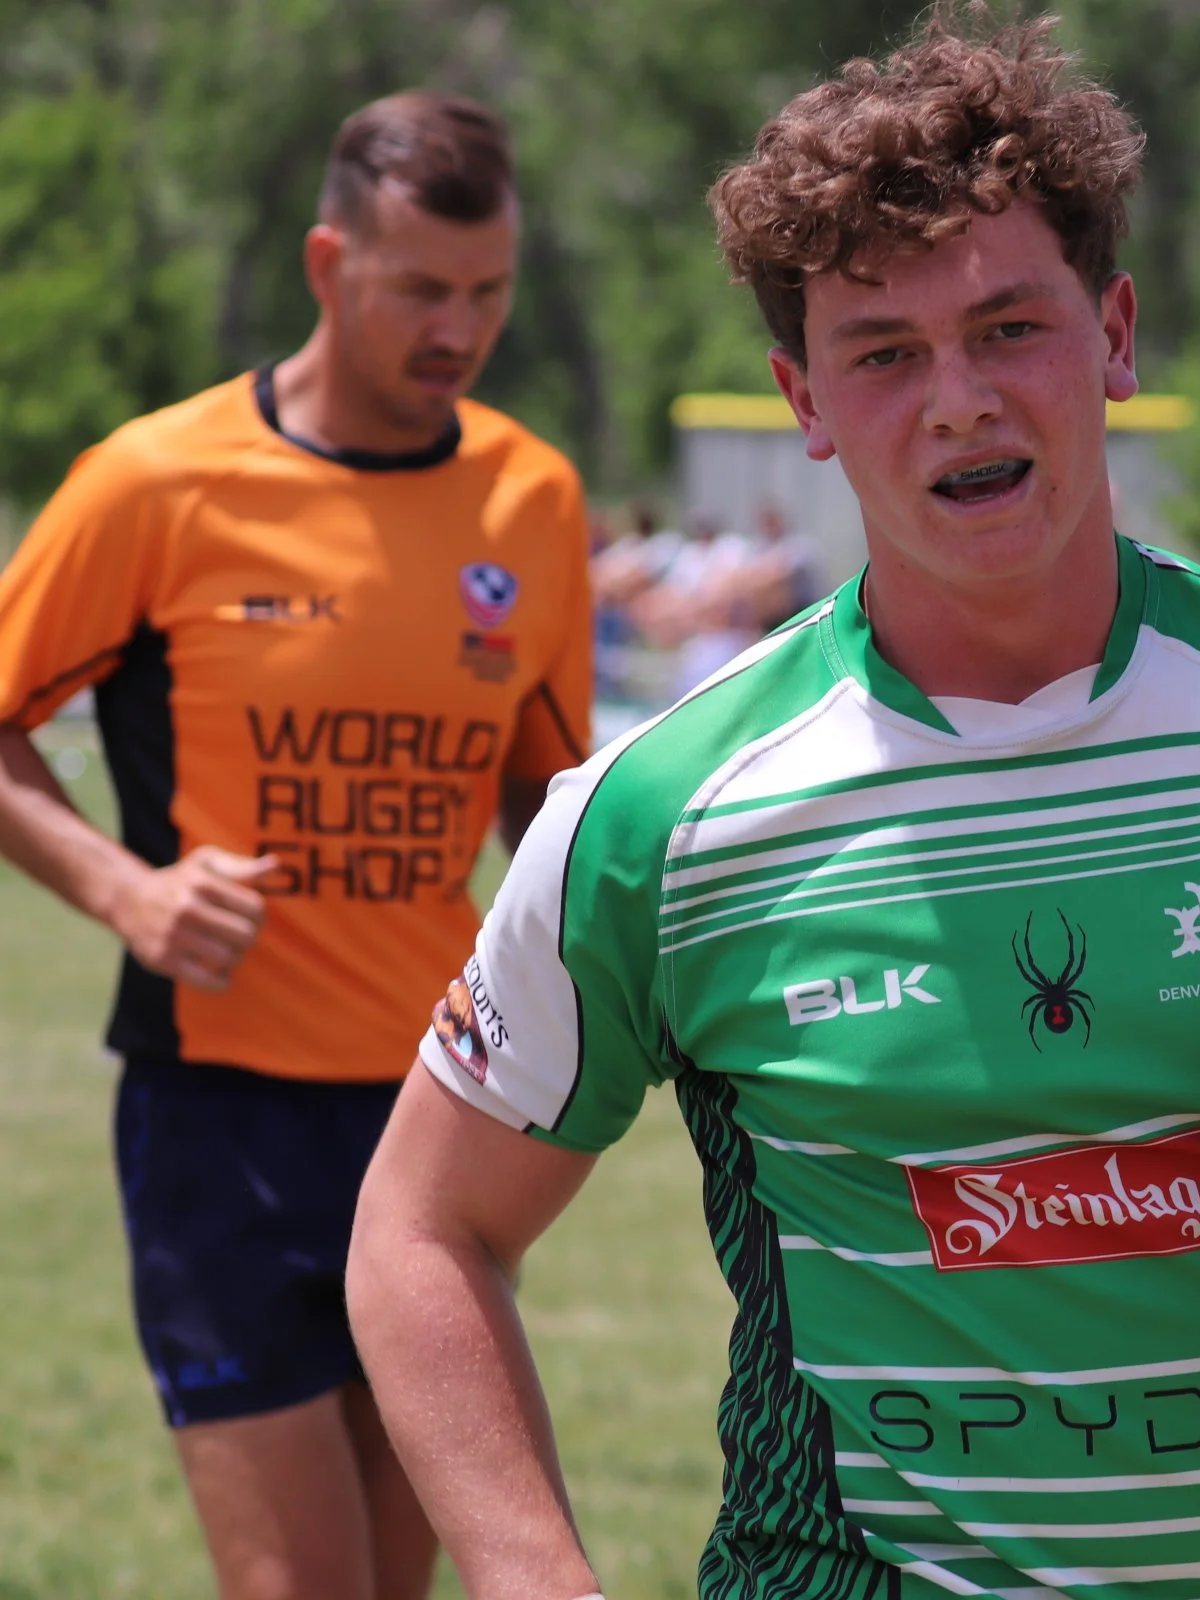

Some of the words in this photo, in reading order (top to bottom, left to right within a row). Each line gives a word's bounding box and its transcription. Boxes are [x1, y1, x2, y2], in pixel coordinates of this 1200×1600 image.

[961, 463, 1006, 480] SHOCK
[246, 706, 498, 773] WORLD
[257, 774, 472, 838] RUGBY
[255, 841, 443, 904] SHOP
[783, 964, 943, 1026] BLK
